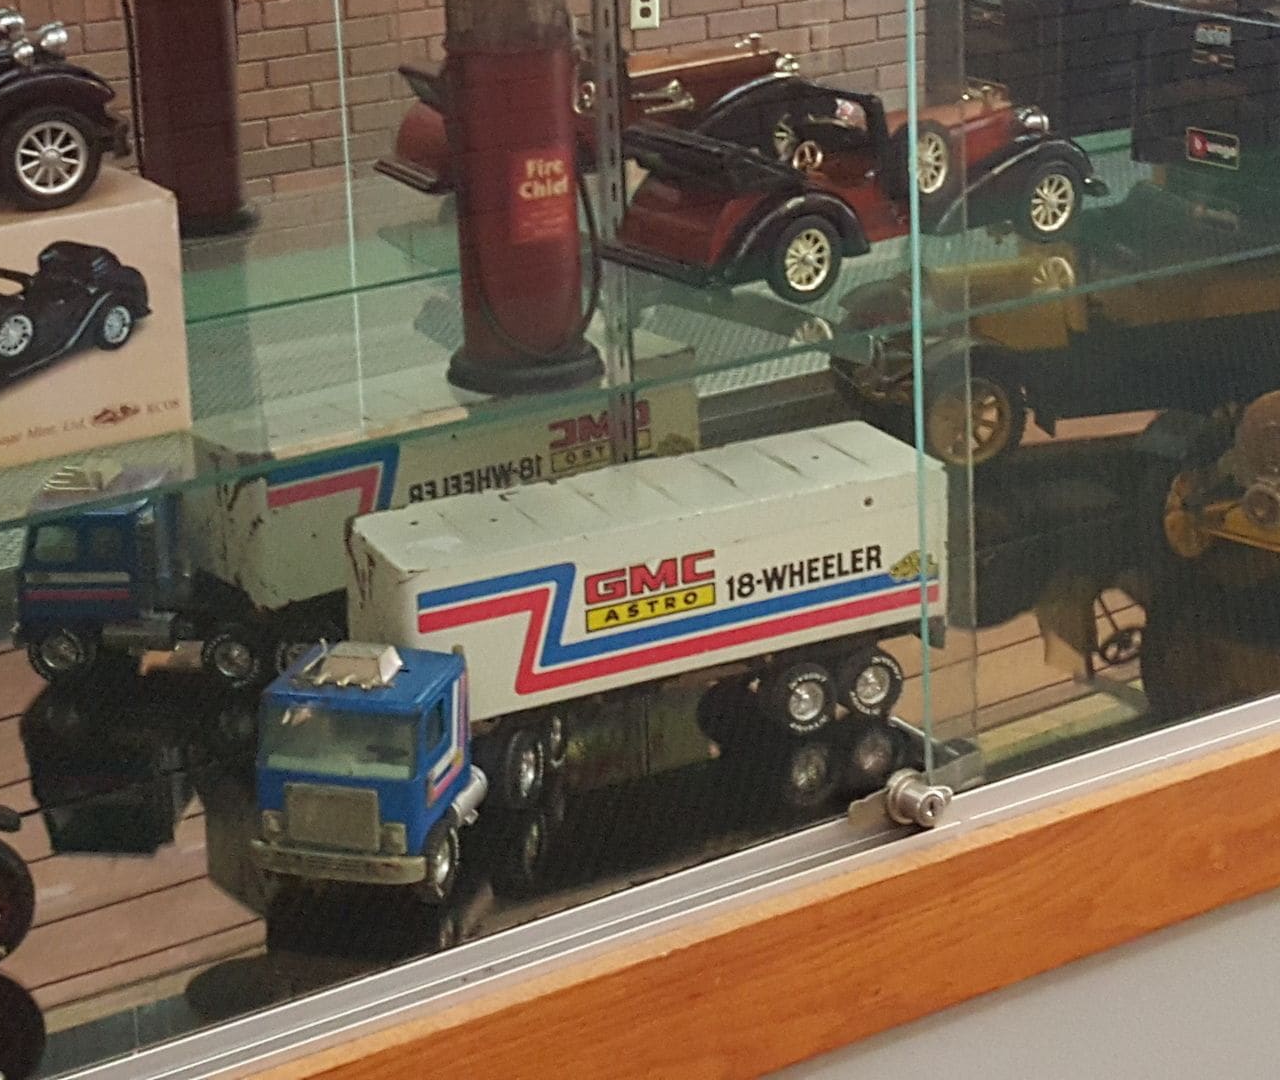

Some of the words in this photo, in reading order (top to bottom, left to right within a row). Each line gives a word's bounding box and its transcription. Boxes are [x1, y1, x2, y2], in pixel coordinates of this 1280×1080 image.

[525, 158, 565, 178] Fire
[518, 175, 568, 200] Chief
[584, 549, 716, 605] GMC
[725, 544, 882, 601] 18-WHEELER
[605, 592, 698, 623] ASTRO
